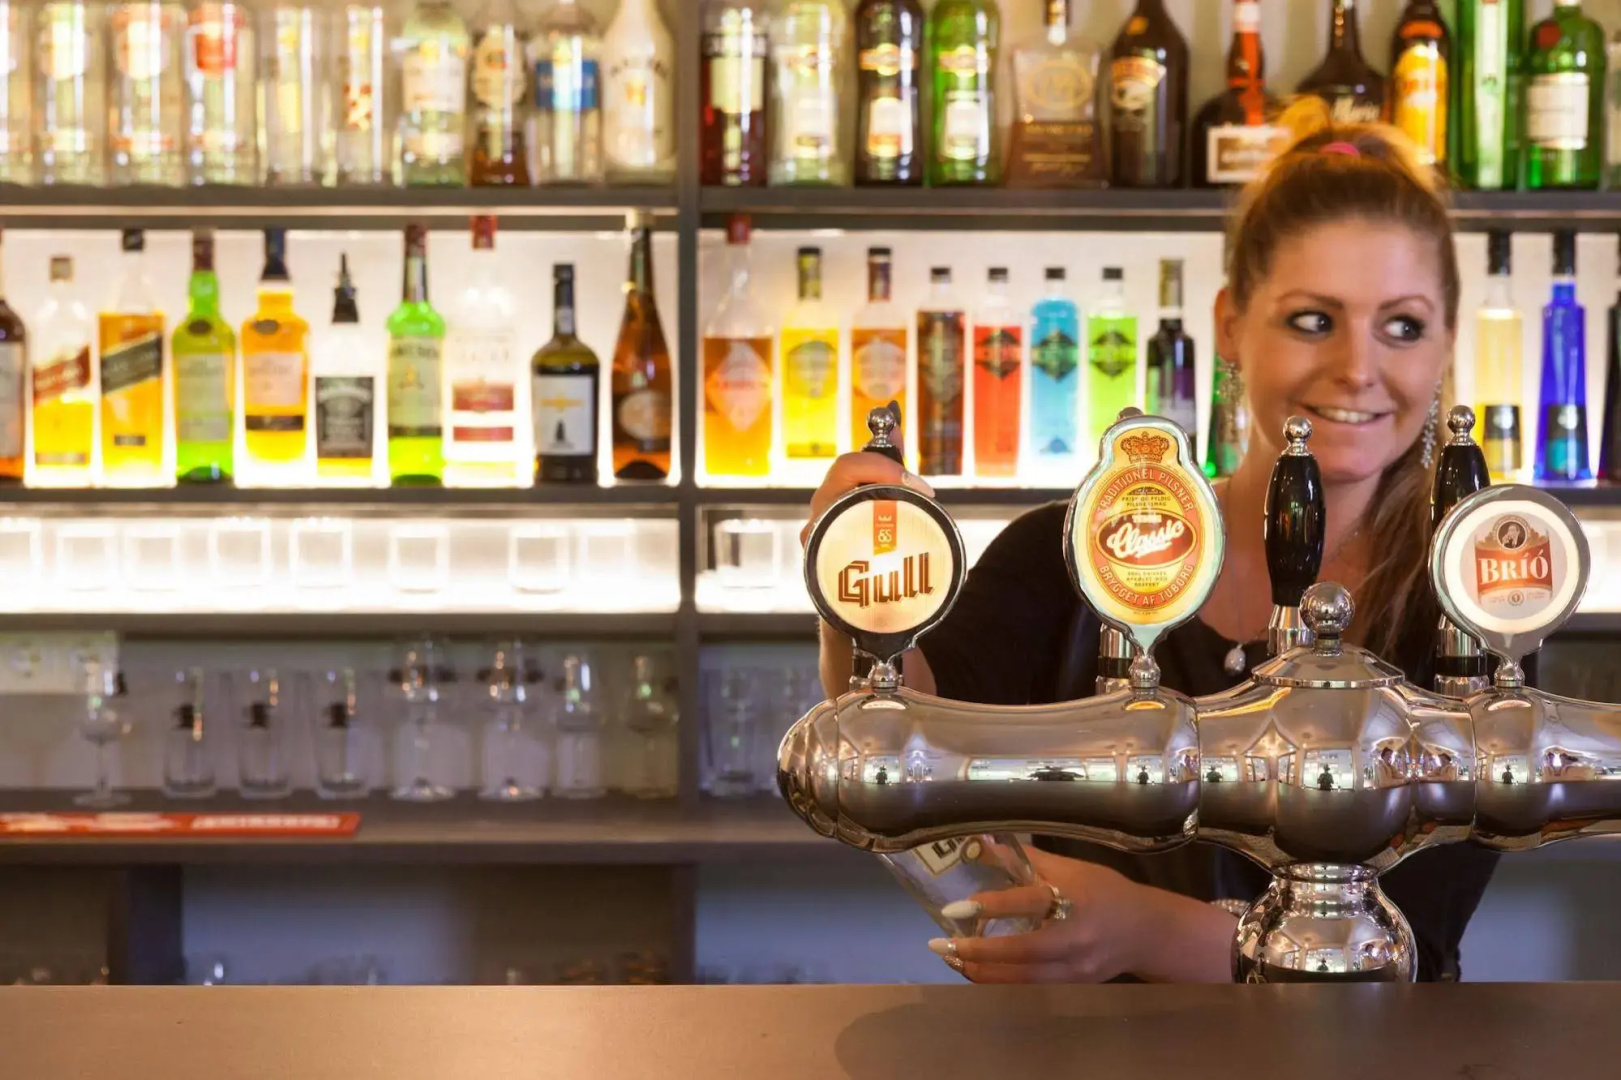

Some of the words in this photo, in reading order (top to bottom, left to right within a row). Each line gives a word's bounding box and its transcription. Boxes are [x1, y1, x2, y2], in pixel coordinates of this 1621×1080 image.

[1096, 468, 1155, 513] TRADITIONEL
[1158, 471, 1195, 512] PILSNER
[1106, 519, 1185, 559] Classic
[837, 551, 934, 609] Gull
[1099, 565, 1140, 604] BRYGGET
[1142, 594, 1156, 605] AF
[1160, 564, 1194, 602] TUBORG
[1478, 549, 1549, 585] BRÍÓ
